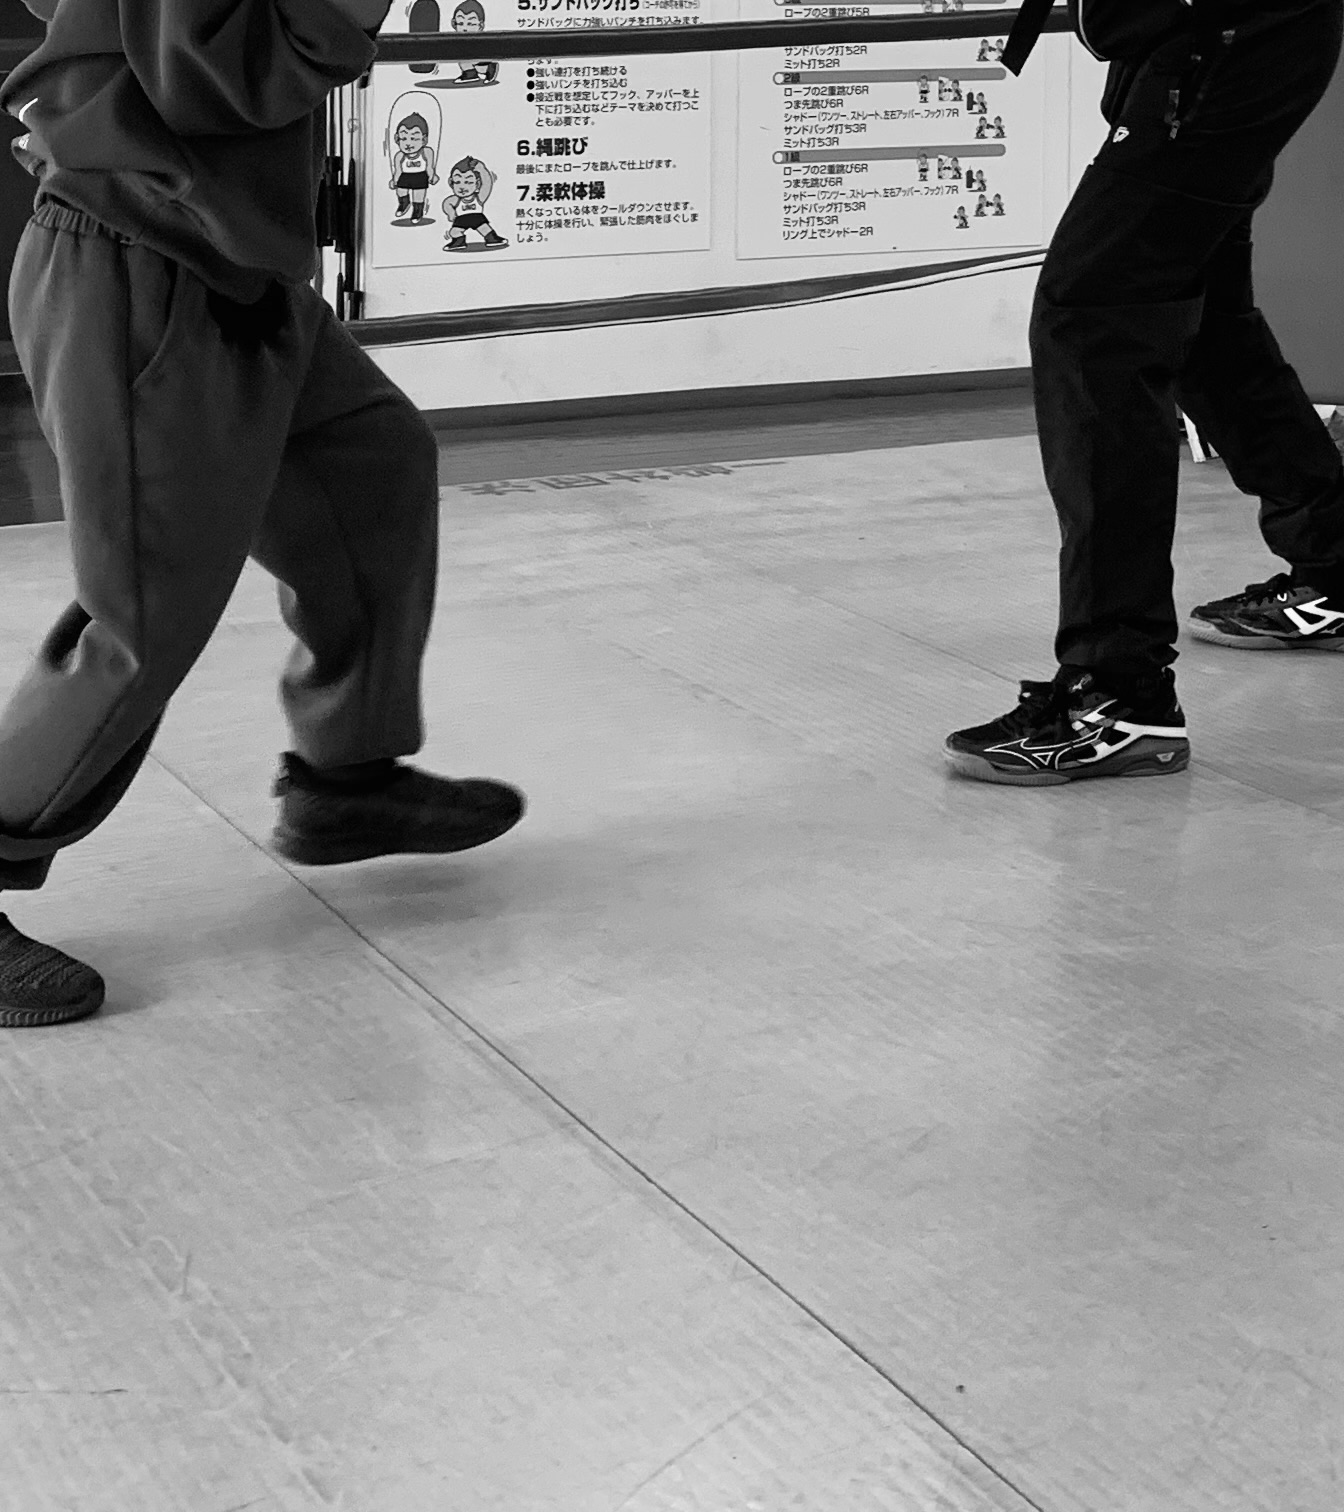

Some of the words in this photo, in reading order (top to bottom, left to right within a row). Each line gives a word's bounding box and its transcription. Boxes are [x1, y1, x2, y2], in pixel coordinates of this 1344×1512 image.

[784, 6, 870, 17] ロープの2重跳び5R
[517, 15, 703, 29] サンドバッグに力強いパンチを打ち込みます。
[784, 45, 868, 56] サンドバッグ打ち2R
[784, 58, 840, 69] ミット打ち2R
[535, 65, 627, 78] 強い連打を打ち続ける
[535, 78, 627, 90] 強いパンチを打ち込む
[535, 88, 699, 102] 接近戦を想定してフック、アッパーを上
[784, 85, 869, 96] ロープの2重跳び6R
[535, 100, 699, 115] 下に打ち込むなどテーマを決めて打つこ
[783, 98, 843, 109] つま先跳び6R
[535, 116, 595, 127] とも必要です。
[783, 123, 867, 135] サンドバッグ打ち3R
[517, 137, 588, 157] 6.縄跳び
[783, 136, 839, 148] ミット打ち3R
[516, 159, 677, 175] 最後にまたロープを跳んで仕上げます。
[783, 163, 868, 175] ロープの2重跳び6R
[783, 176, 843, 188] つま先跳び6R
[516, 181, 605, 201] 7.柔軟体操
[516, 201, 694, 218] 熱くなっている体をクールダウンさせます。
[783, 201, 866, 213] サンドバッグ打ち3R
[516, 213, 698, 231] 十分に体操を行い、緊張した筋肉をほぐしま
[782, 215, 838, 227] ミット打ち3R
[516, 232, 548, 243] しょう。
[782, 226, 873, 240] リング上でシャドー2R
